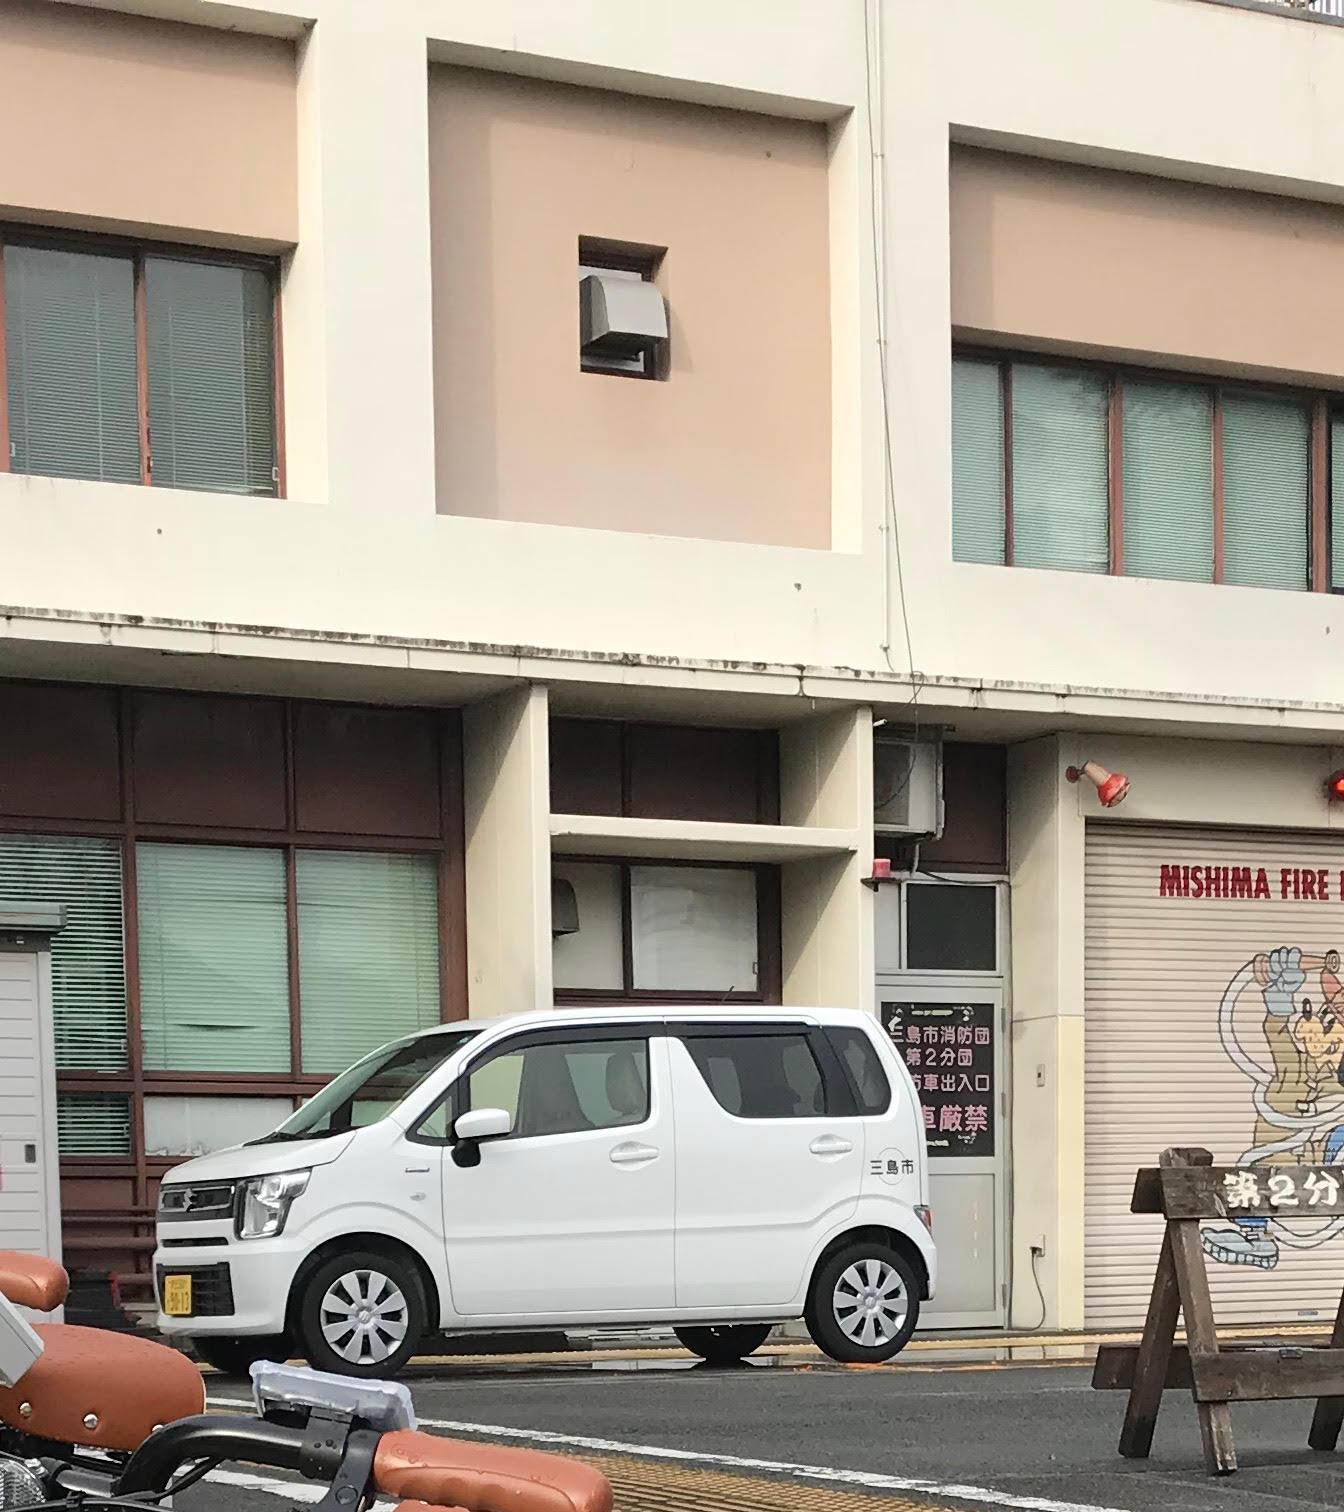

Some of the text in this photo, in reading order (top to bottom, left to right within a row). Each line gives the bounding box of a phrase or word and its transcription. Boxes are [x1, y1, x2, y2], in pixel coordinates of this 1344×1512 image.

[1159, 864, 1271, 899] MISHIMA
[1280, 868, 1329, 900] FIRE
[890, 1025, 990, 1045] 三島市消防団
[906, 1047, 972, 1067] 第2分団
[870, 1160, 913, 1175] 三島市
